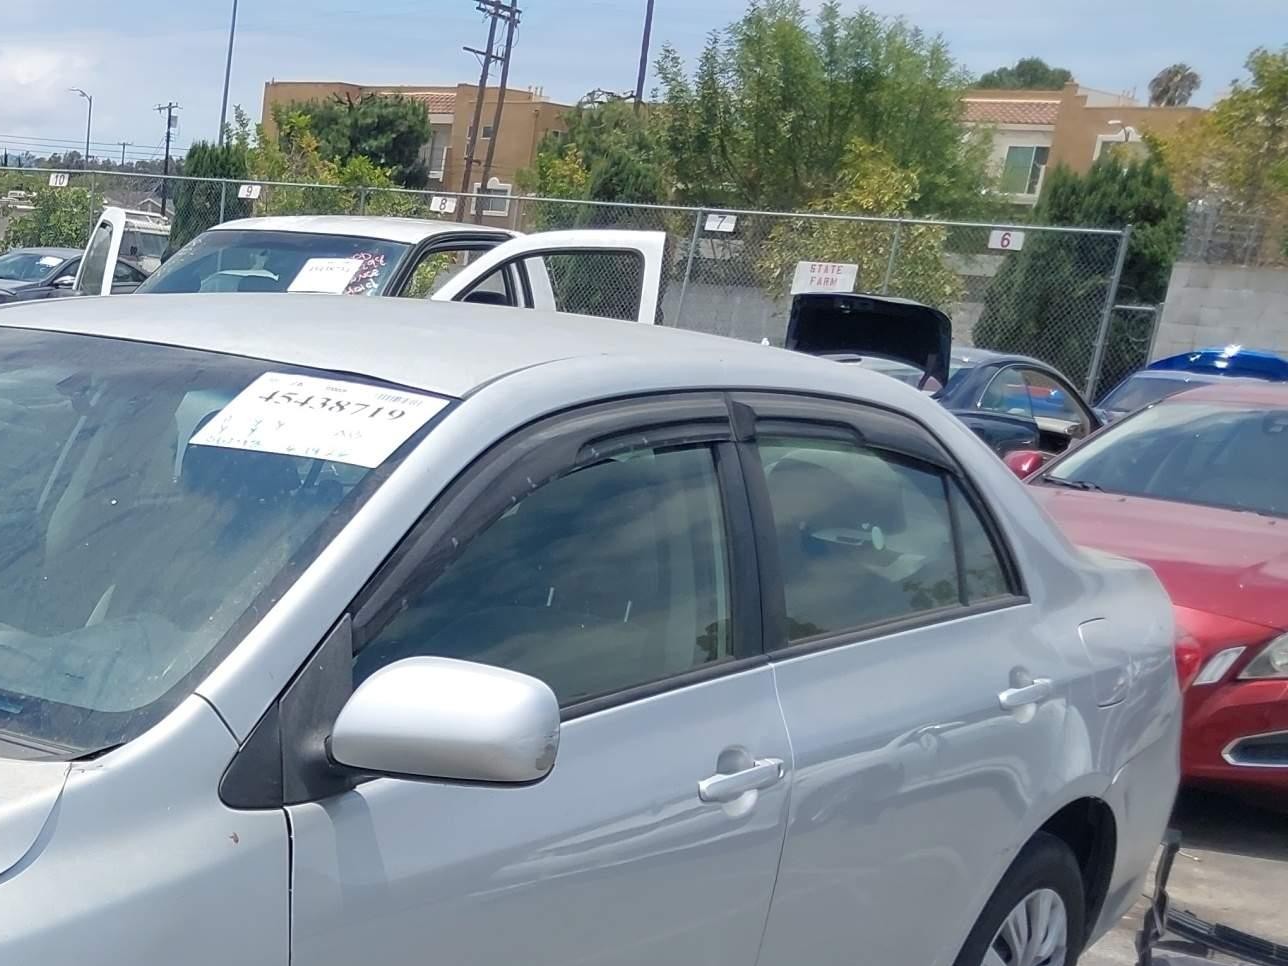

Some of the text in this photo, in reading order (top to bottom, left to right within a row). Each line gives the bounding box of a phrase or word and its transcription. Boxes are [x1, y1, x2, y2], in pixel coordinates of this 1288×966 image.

[55, 174, 65, 185] 10
[246, 185, 253, 197] 9
[439, 198, 447, 210] 8
[716, 215, 727, 230] 7
[1000, 232, 1011, 248] 6
[810, 264, 843, 275] STATE
[810, 276, 838, 287] FARM
[259, 389, 406, 421] 45438719
